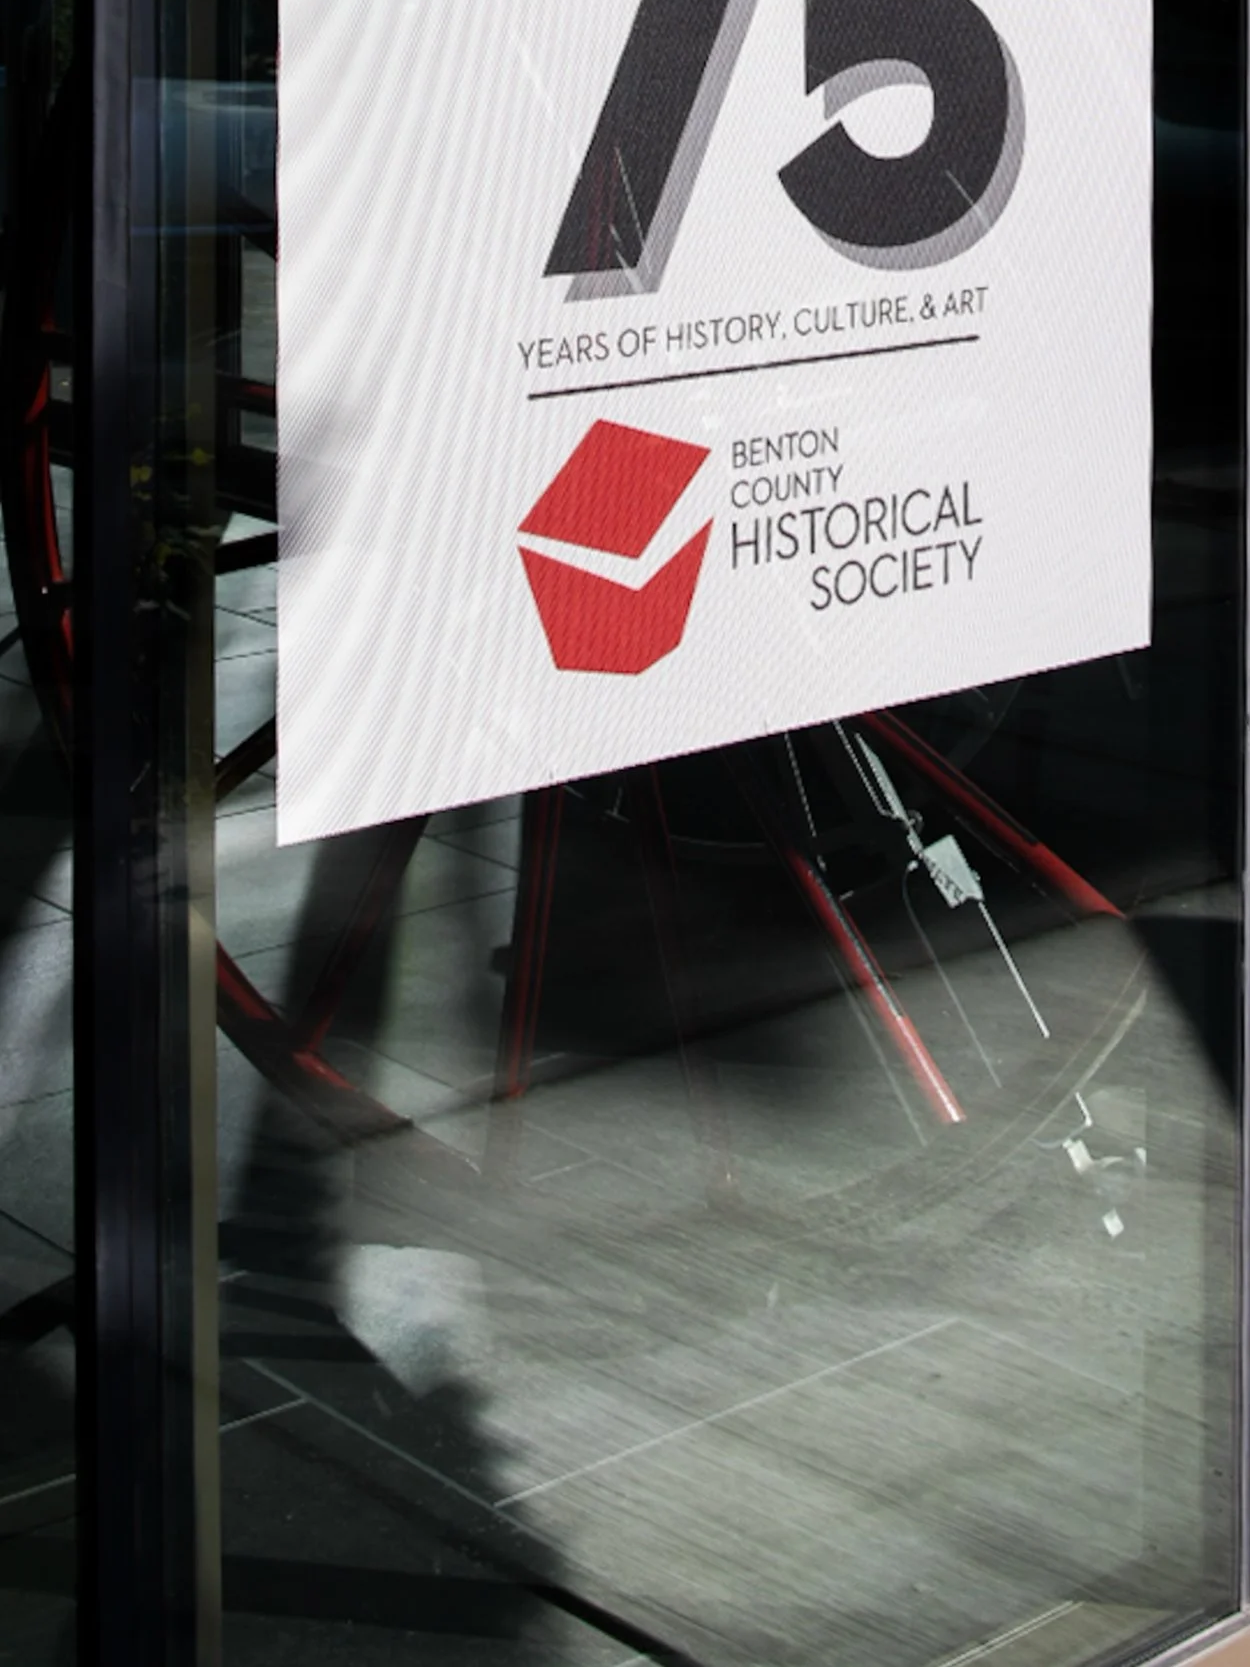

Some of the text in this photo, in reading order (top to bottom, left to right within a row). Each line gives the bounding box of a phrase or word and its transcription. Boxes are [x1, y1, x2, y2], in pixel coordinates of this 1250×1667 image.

[517, 332, 610, 370] YEARS
[617, 325, 658, 358] OF
[666, 311, 788, 353] HISTORY,
[919, 292, 938, 321] &
[942, 286, 990, 317] ART
[731, 426, 841, 470] BENTON
[730, 464, 845, 510] COUNTY
[730, 481, 984, 570] HISTORICAL
[809, 536, 984, 612] SOCIETY
